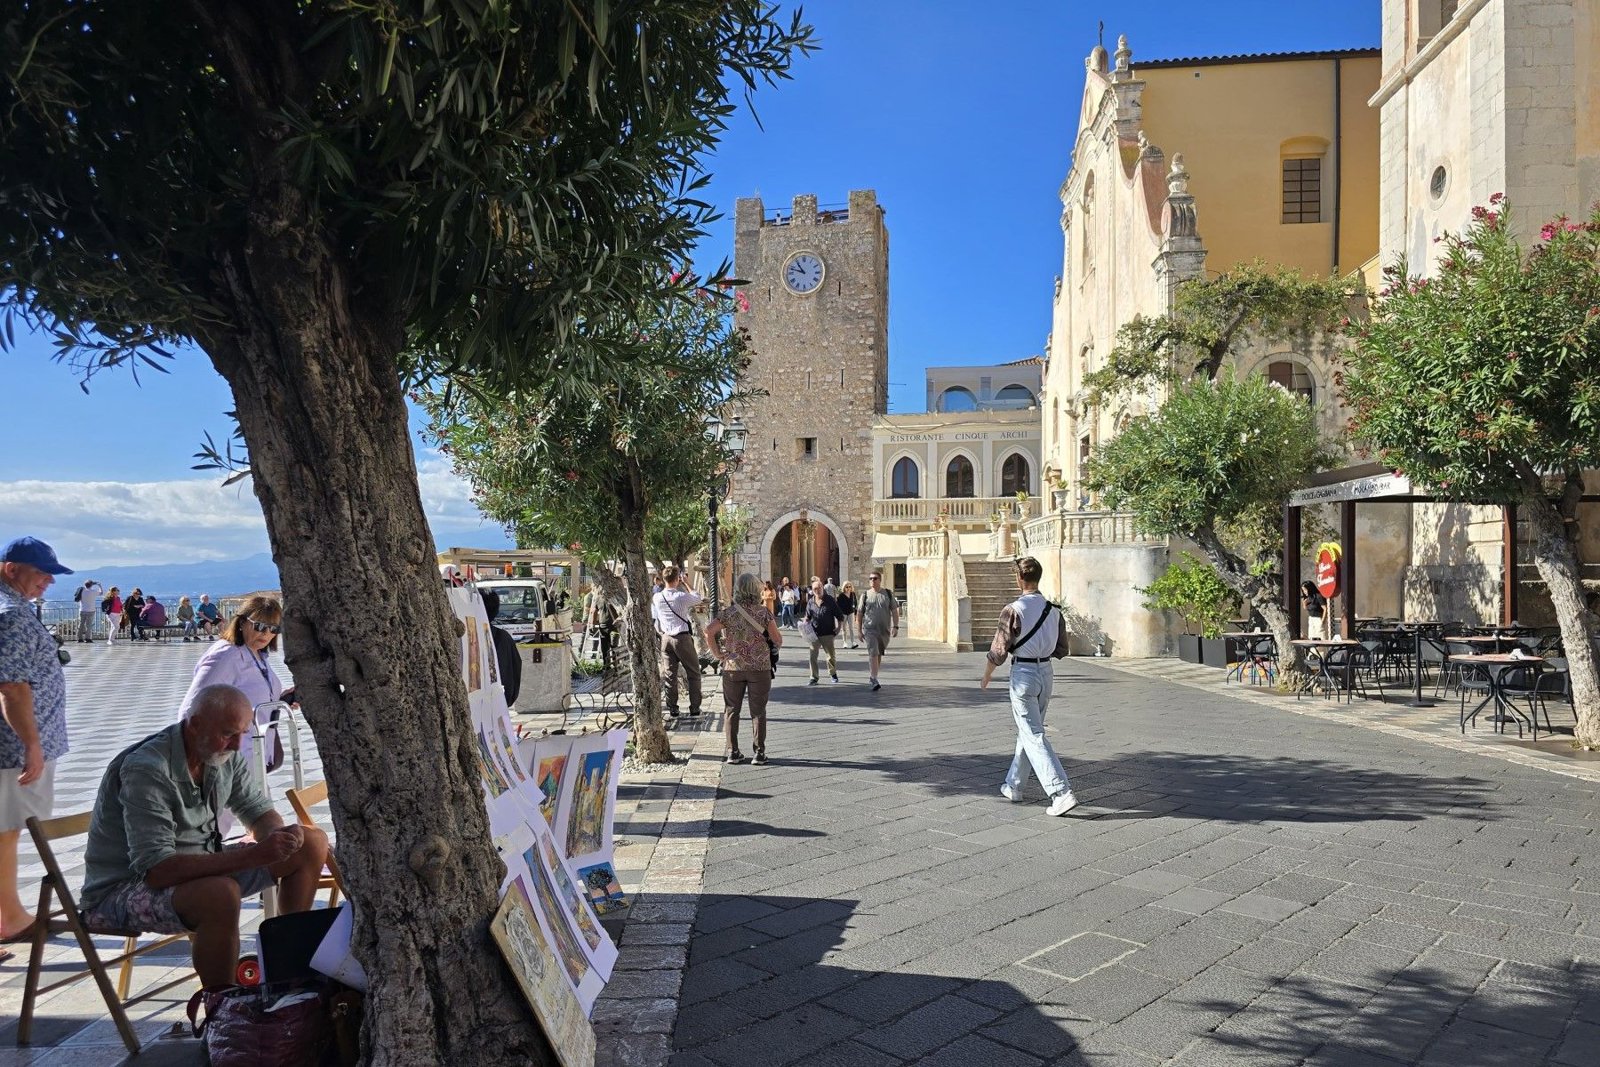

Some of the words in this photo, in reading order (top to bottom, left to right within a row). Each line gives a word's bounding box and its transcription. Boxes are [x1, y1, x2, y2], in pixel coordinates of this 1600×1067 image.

[890, 433, 944, 442] RISTORANTE
[955, 432, 988, 440] CINQUE
[1000, 431, 1028, 439] ARCHI
